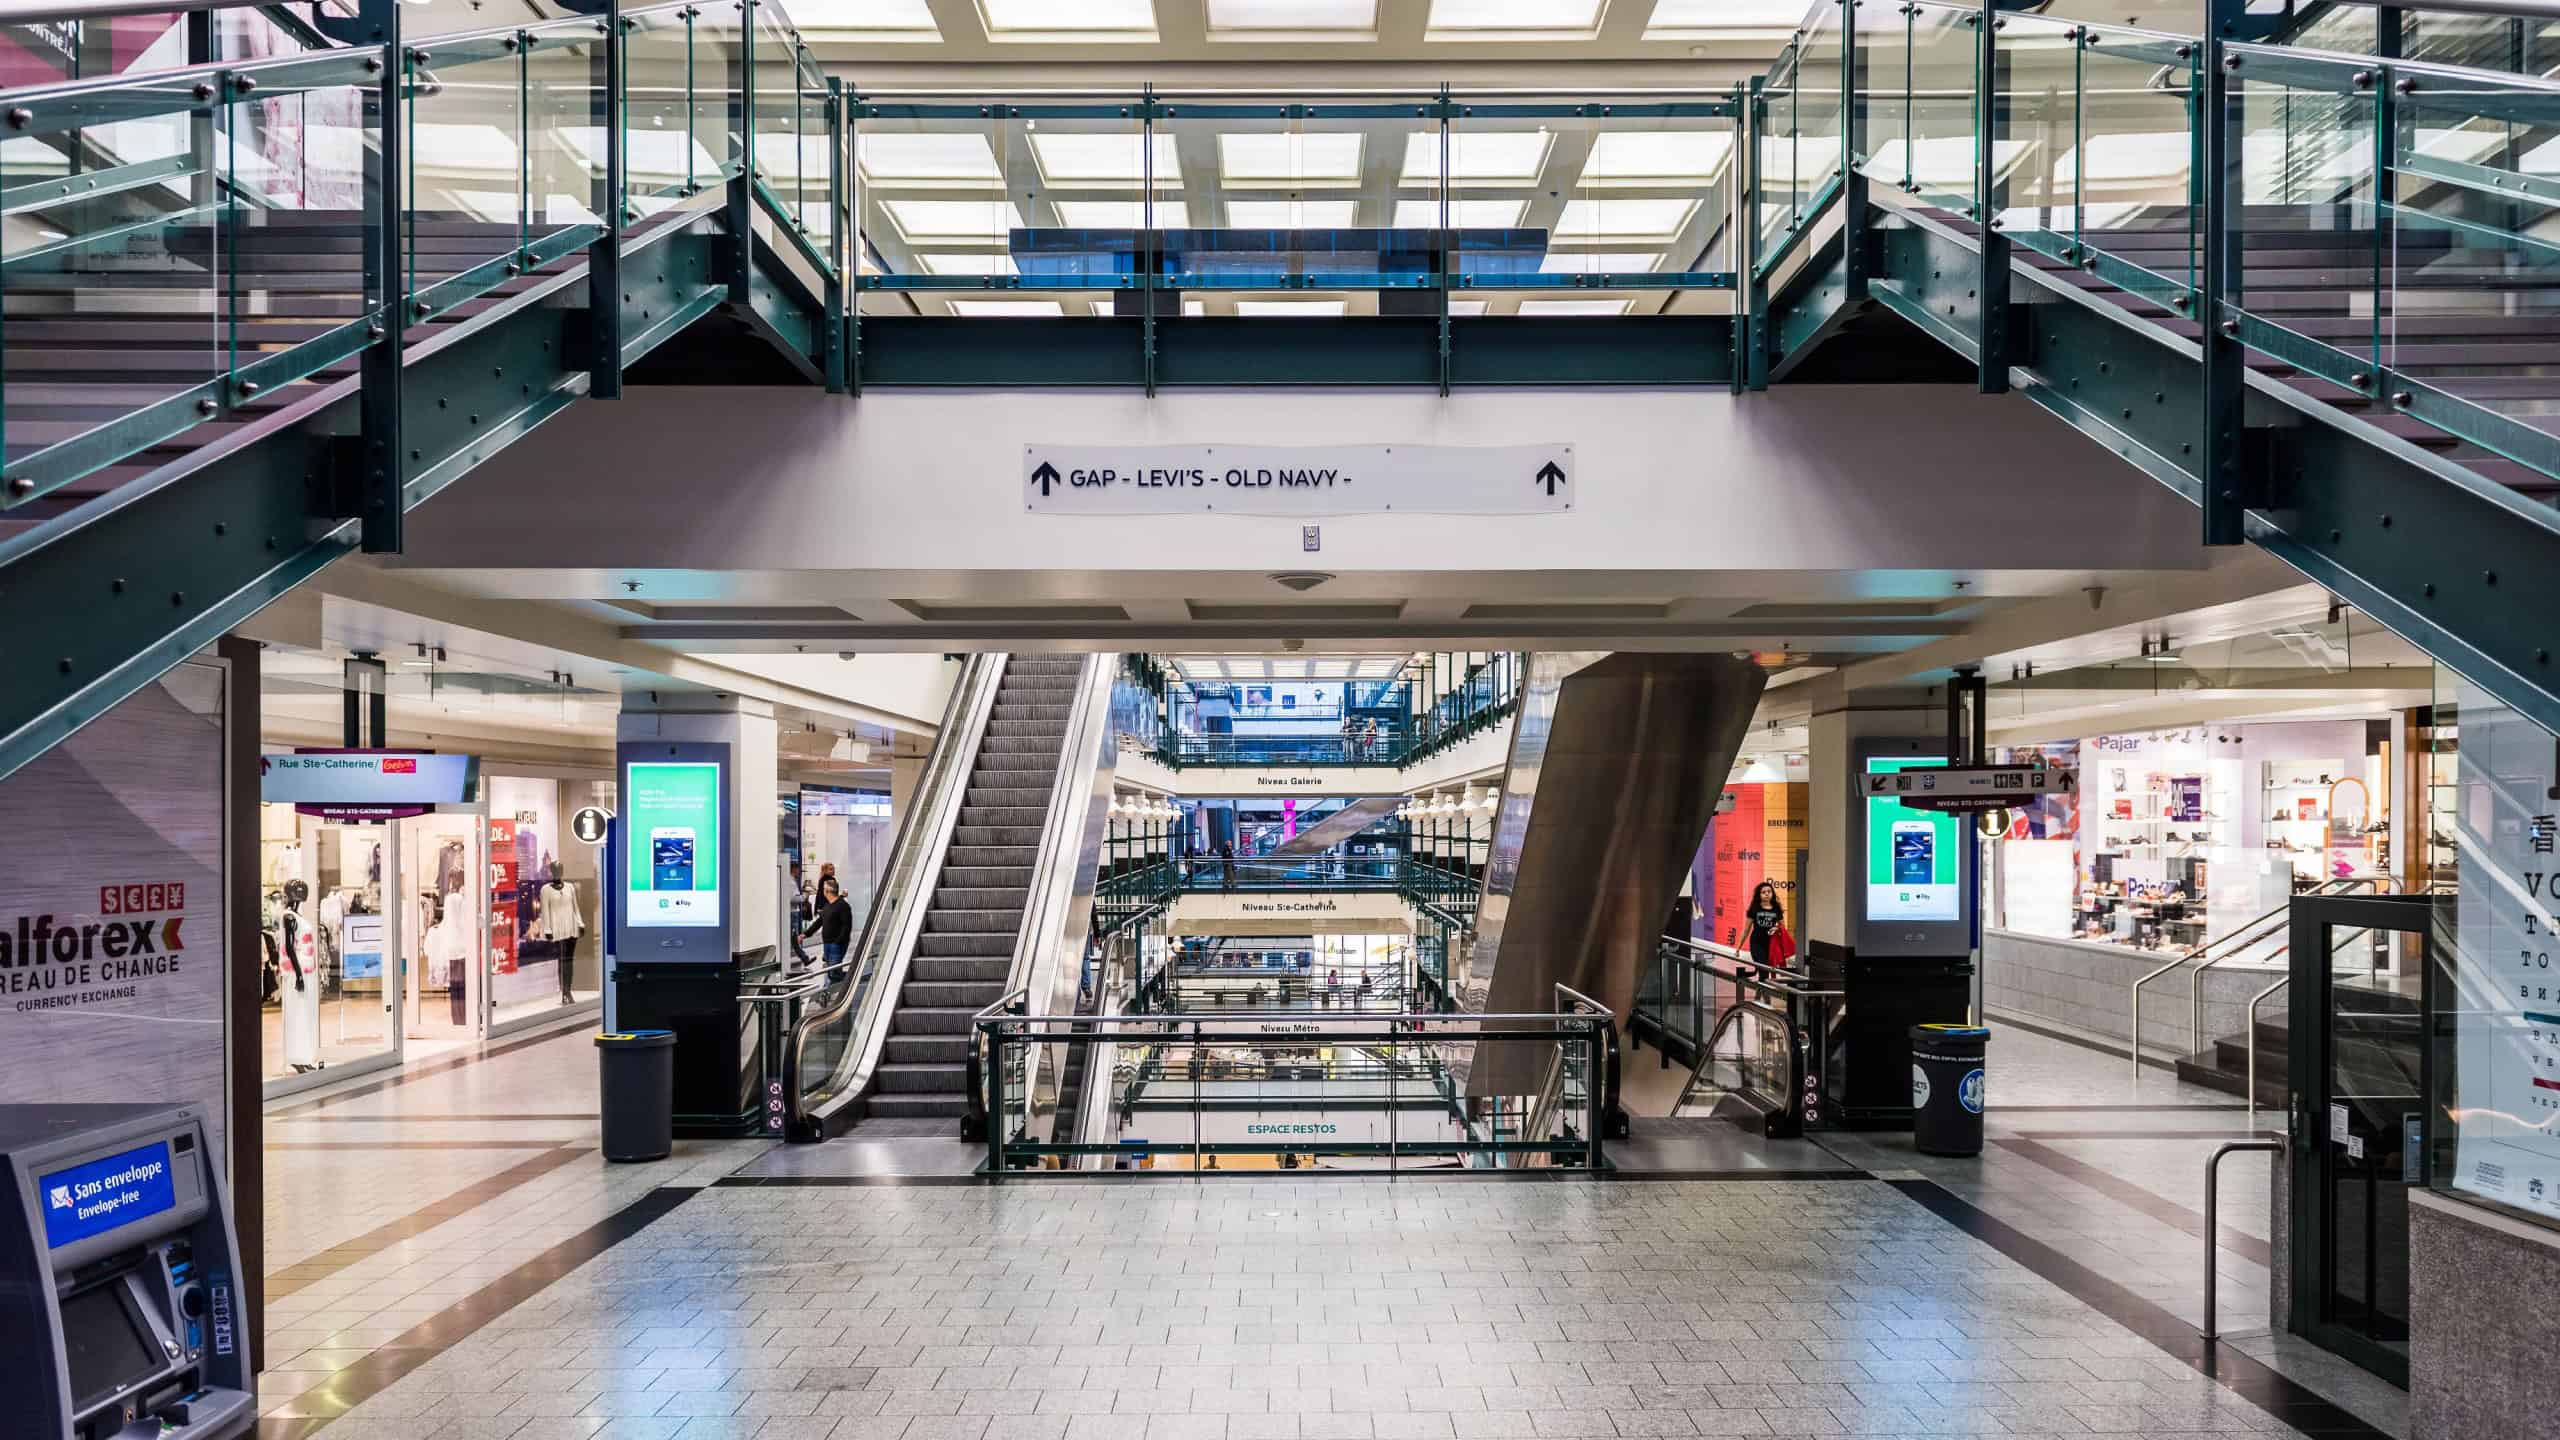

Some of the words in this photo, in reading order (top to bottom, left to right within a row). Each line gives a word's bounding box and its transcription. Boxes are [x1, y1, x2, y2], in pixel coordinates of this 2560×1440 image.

[1069, 469, 1116, 488] GAP
[1137, 469, 1204, 488] LEVI'S
[1225, 469, 1273, 488] OLD
[1279, 469, 1338, 488] NAVY
[2100, 736, 2140, 752] Pajar
[279, 759, 299, 769] Rue
[1257, 777, 1288, 785] Niveau
[1290, 777, 1322, 785] Galerie
[1242, 903, 1274, 911] Niveau
[65, 964, 91, 986] DE
[101, 954, 180, 982] CHANGE
[16, 993, 78, 1012] CURRENCY
[82, 985, 136, 1003] EXCHANGE
[1260, 1024, 1291, 1033] Niveau
[1293, 1024, 1320, 1033] Métro
[1247, 1124, 1290, 1134] ESPACE
[1292, 1124, 1337, 1134] RESTOS
[74, 1180, 103, 1201] Sans
[104, 1161, 162, 1190] enveloppe
[77, 1190, 140, 1220] Envelope-free
